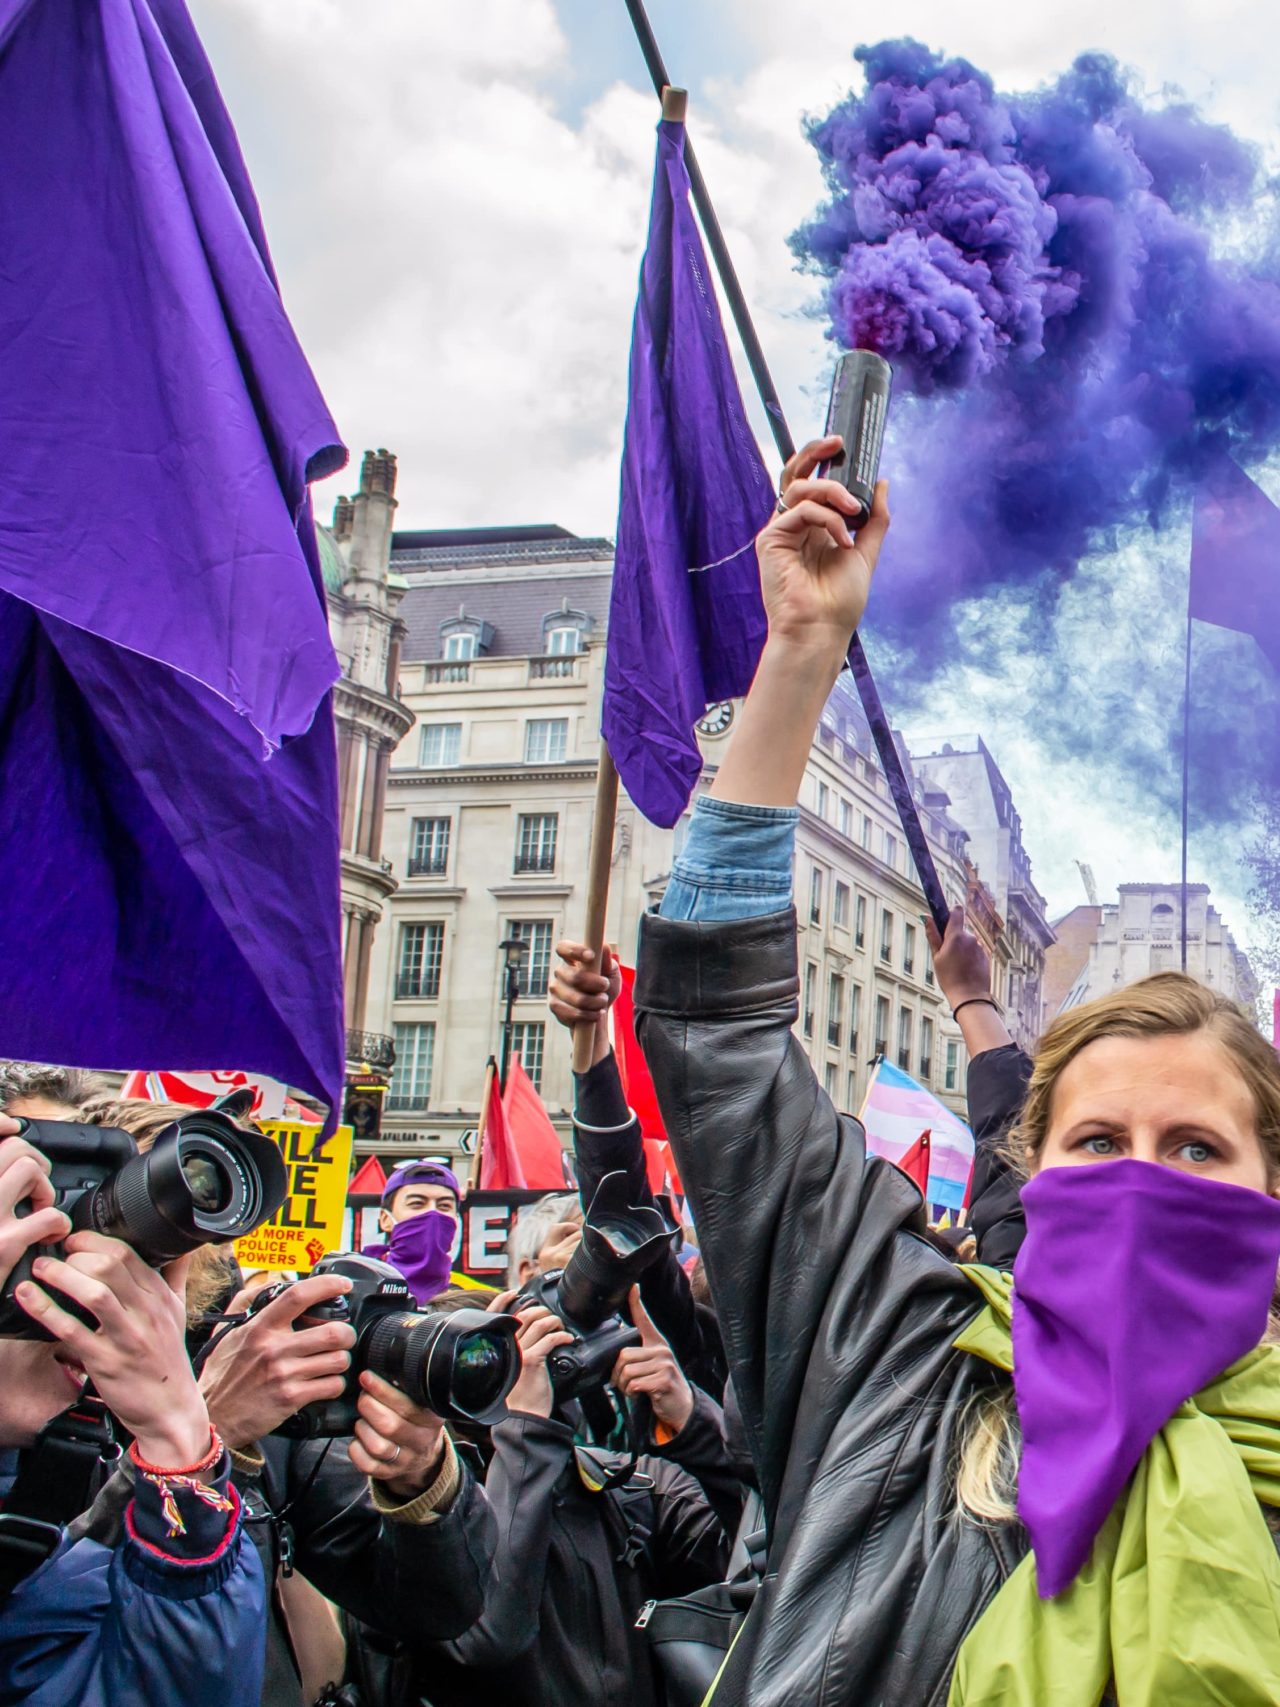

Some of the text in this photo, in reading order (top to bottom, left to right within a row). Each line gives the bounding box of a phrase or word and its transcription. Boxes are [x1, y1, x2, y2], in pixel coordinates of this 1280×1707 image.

[266, 1130, 333, 1164] ILL
[263, 1229, 305, 1241] MORE
[238, 1239, 287, 1252] POLICE
[237, 1251, 296, 1265] POWERS
[382, 1283, 408, 1294] Nikon
